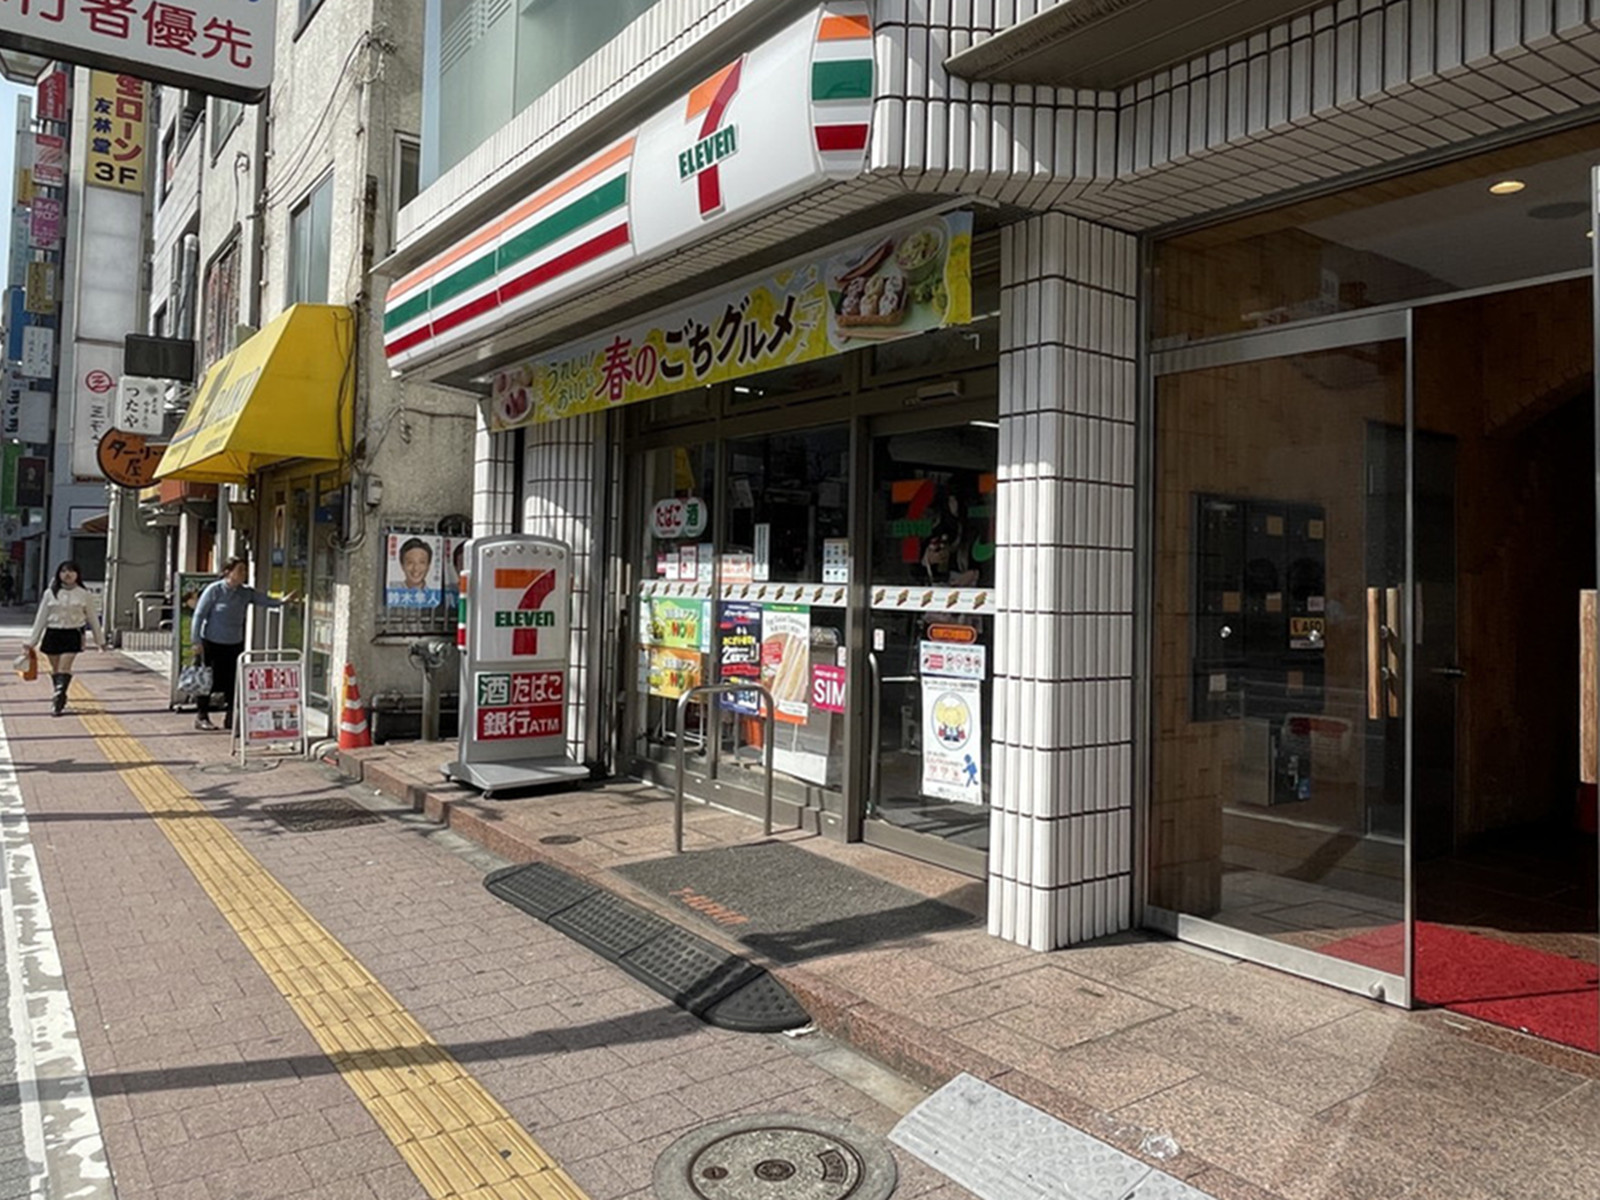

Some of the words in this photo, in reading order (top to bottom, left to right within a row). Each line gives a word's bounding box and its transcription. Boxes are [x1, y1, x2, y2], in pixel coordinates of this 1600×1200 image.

[92, 97, 114, 155] 友林堂
[94, 162, 138, 184] 3F
[595, 295, 796, 401] 春のごちグルメ
[124, 387, 140, 428] つたや
[480, 676, 509, 705] 酒
[512, 674, 563, 702] たばこ
[813, 679, 845, 706] SIM
[483, 710, 560, 737] 銀行ATM
